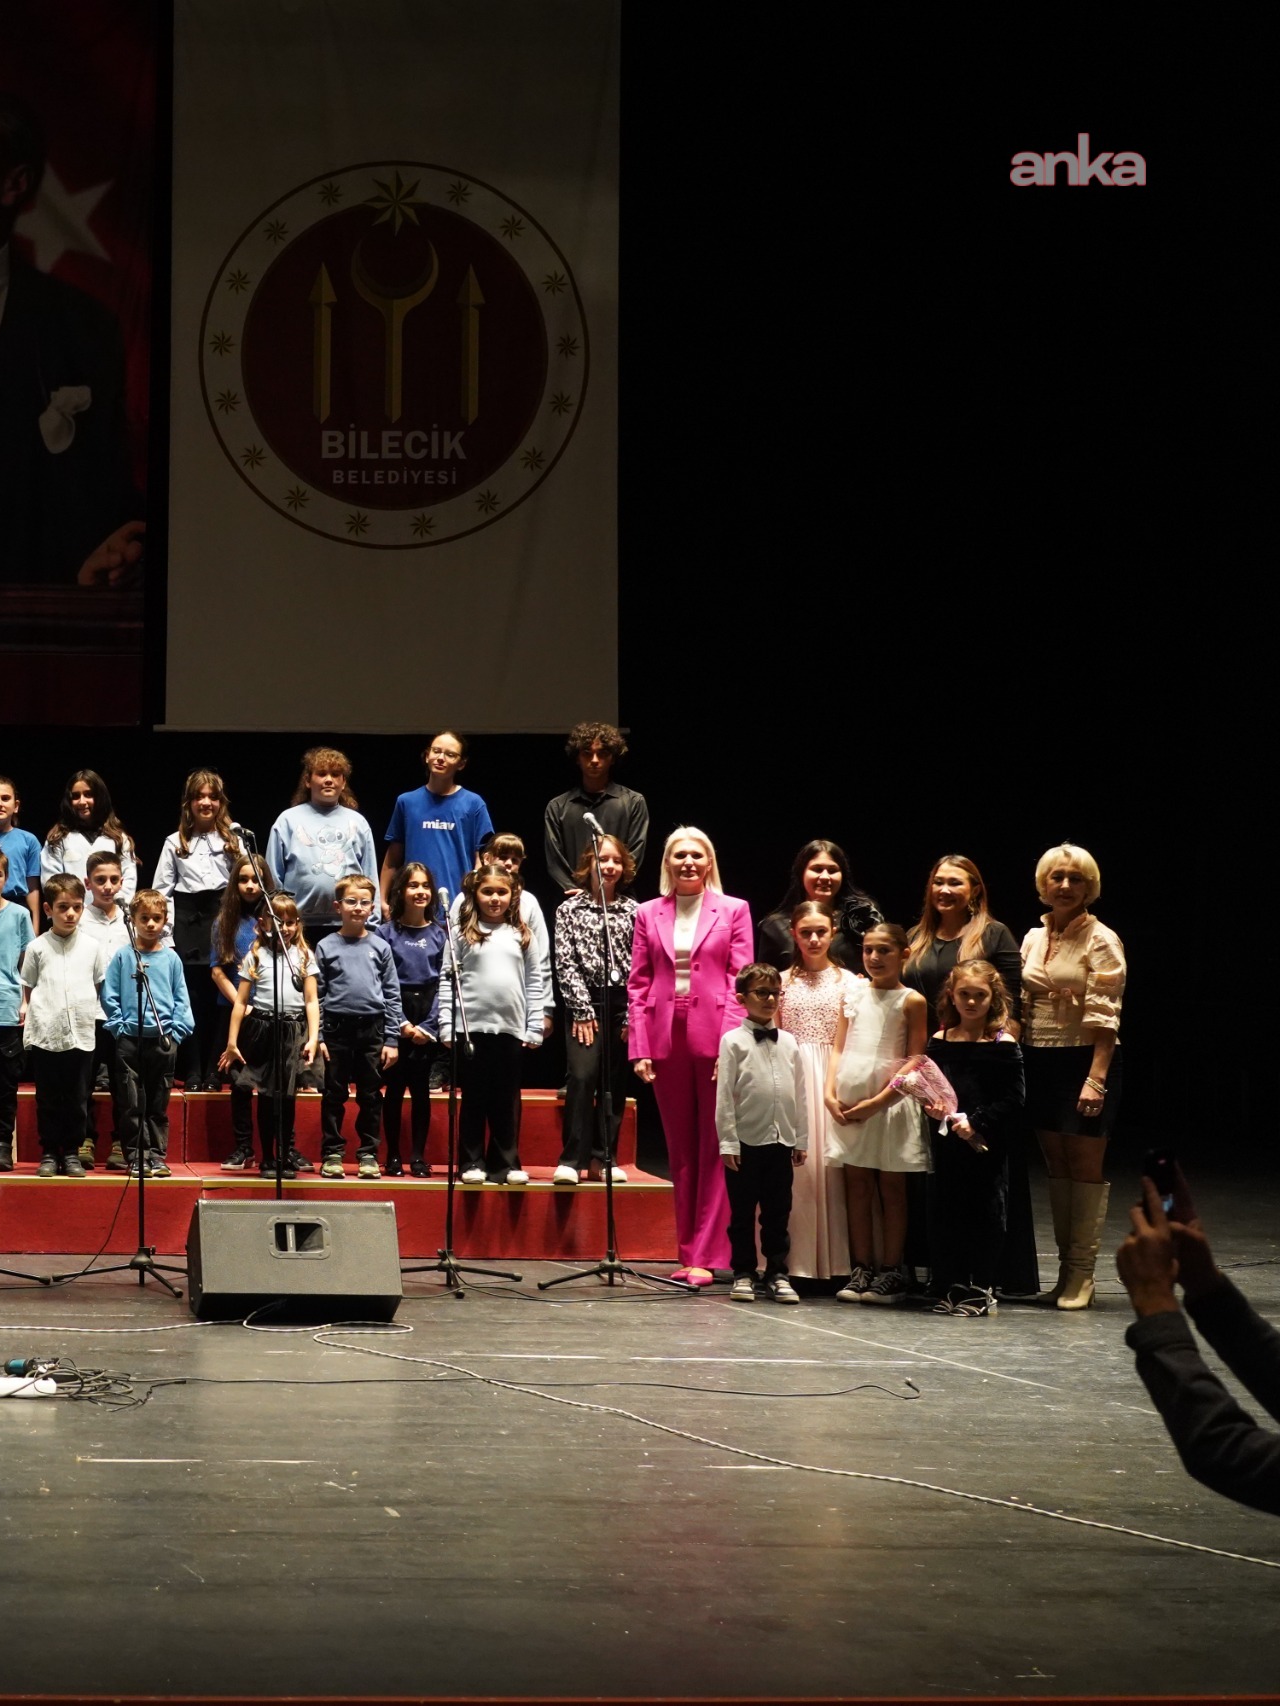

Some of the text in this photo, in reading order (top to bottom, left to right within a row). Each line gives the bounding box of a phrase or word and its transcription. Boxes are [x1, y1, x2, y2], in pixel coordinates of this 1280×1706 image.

[320, 423, 467, 460] BİLECİK
[332, 466, 457, 485] BELEDİYESİ
[422, 819, 456, 831] miav
